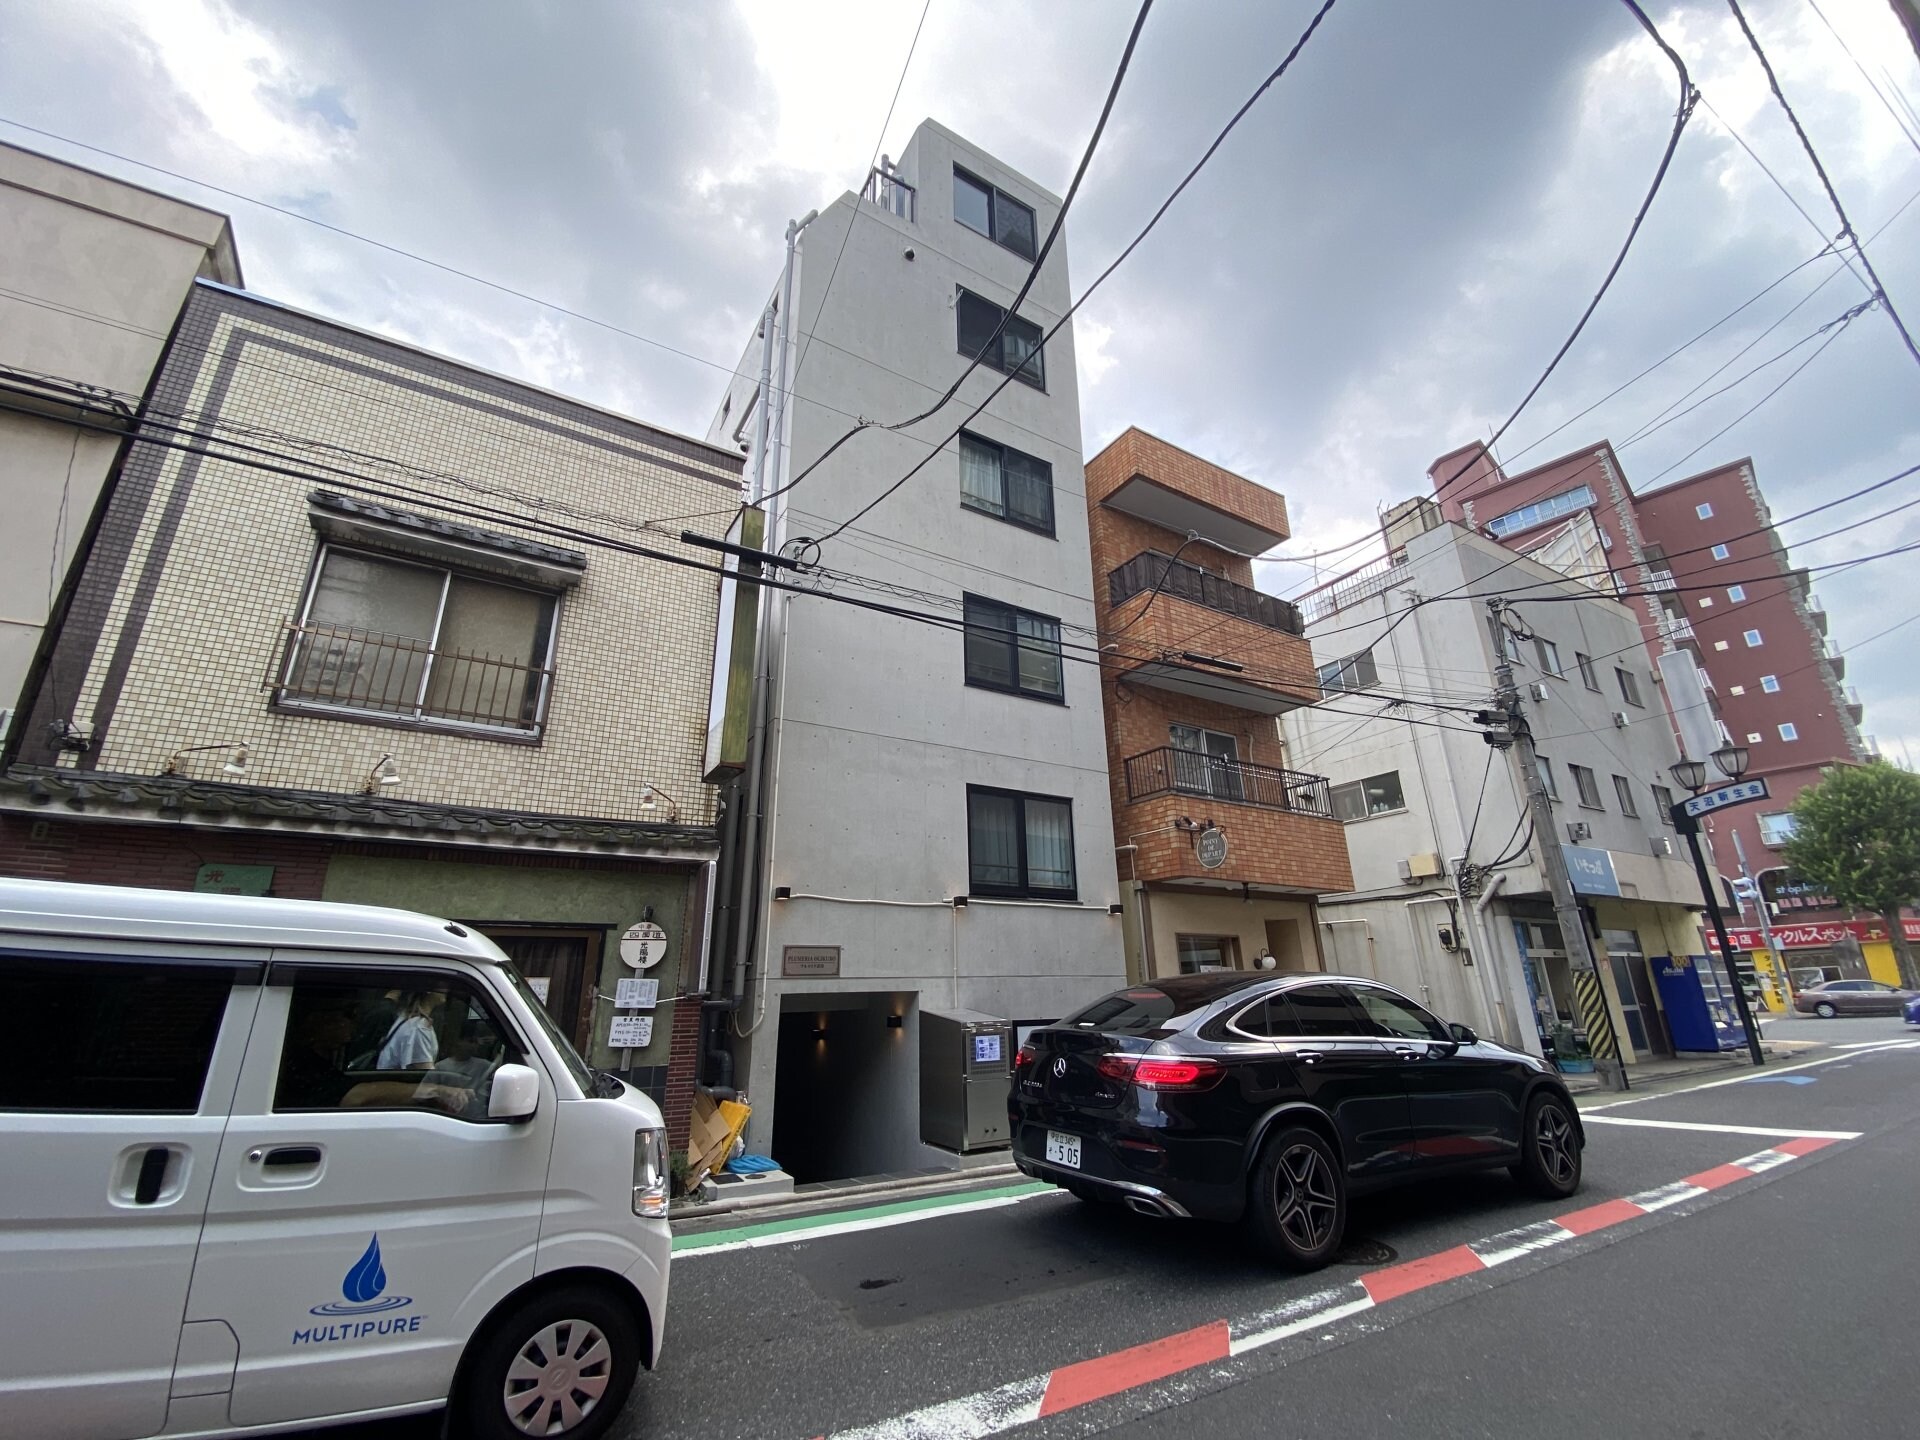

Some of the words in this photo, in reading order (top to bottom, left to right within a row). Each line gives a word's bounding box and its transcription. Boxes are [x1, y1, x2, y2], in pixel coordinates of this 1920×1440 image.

[1688, 784, 1761, 812] 天沼新生会
[292, 1315, 422, 1345] MULTIPURE
